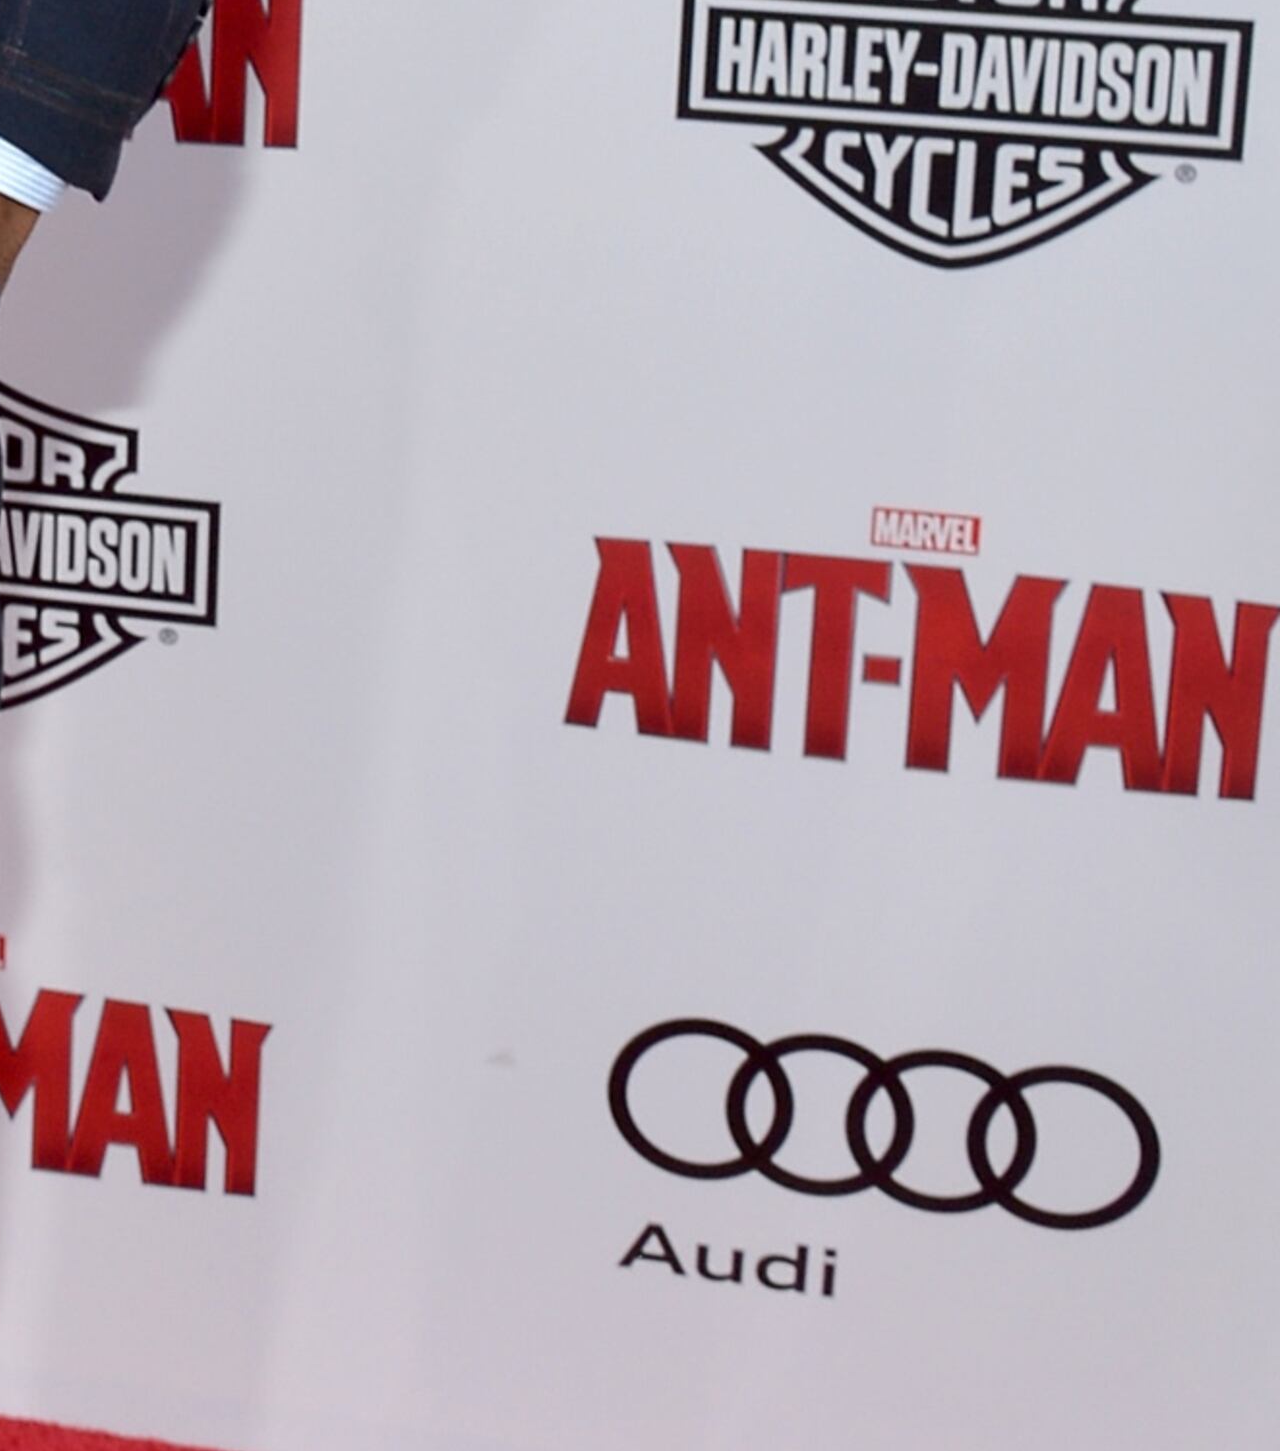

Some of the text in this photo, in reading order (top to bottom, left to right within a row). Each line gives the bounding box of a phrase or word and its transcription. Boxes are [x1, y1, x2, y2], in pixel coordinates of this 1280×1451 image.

[716, 16, 1213, 128] HARLEY-DAVIDSON
[822, 129, 1085, 239] CYCLES
[870, 505, 982, 556] MARVEL
[564, 536, 1280, 803] ANT-MAN
[619, 1223, 838, 1298] Audi
